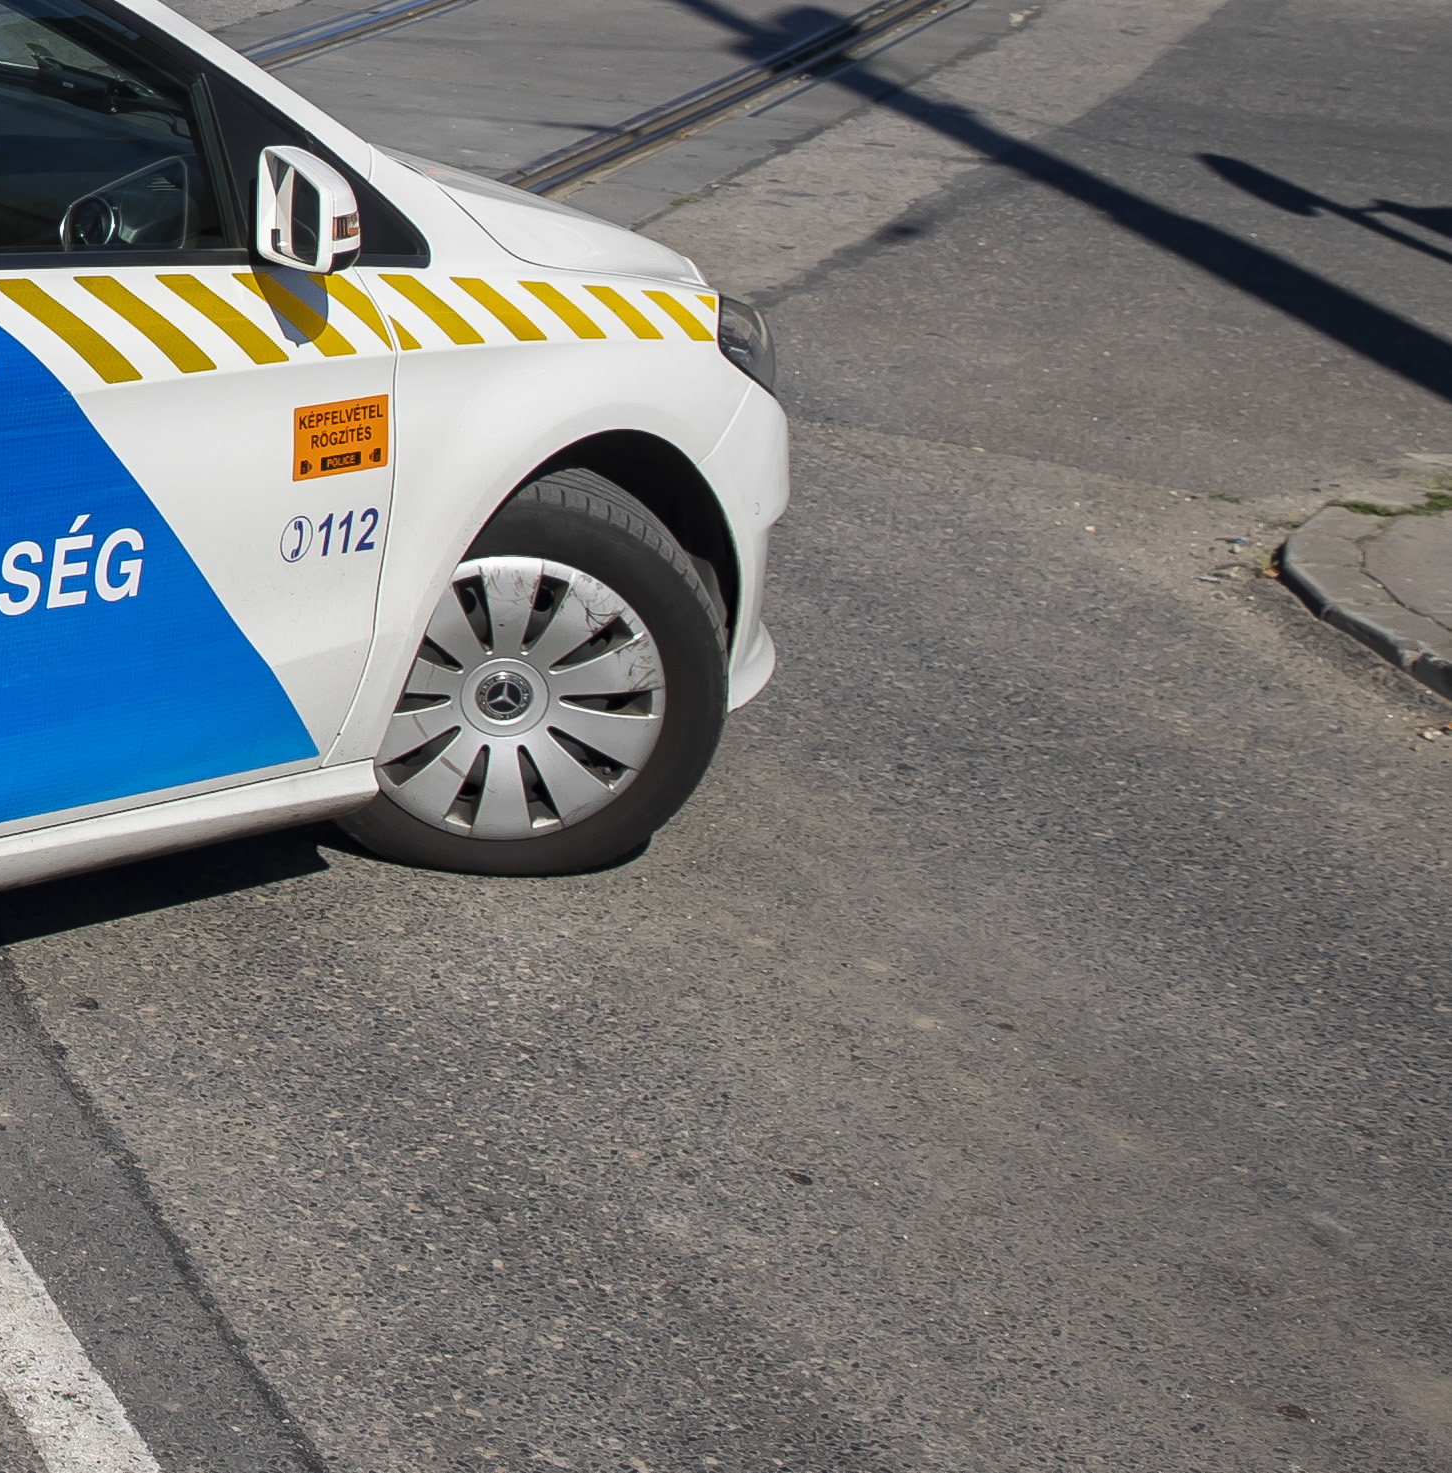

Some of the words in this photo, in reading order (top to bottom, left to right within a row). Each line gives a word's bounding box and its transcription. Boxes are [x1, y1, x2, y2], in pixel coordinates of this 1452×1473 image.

[298, 403, 384, 431] KÉPFELVÉTEL
[310, 423, 372, 450] RÖGZÍTÉS
[326, 454, 357, 468] POLICE
[318, 507, 380, 558] 112
